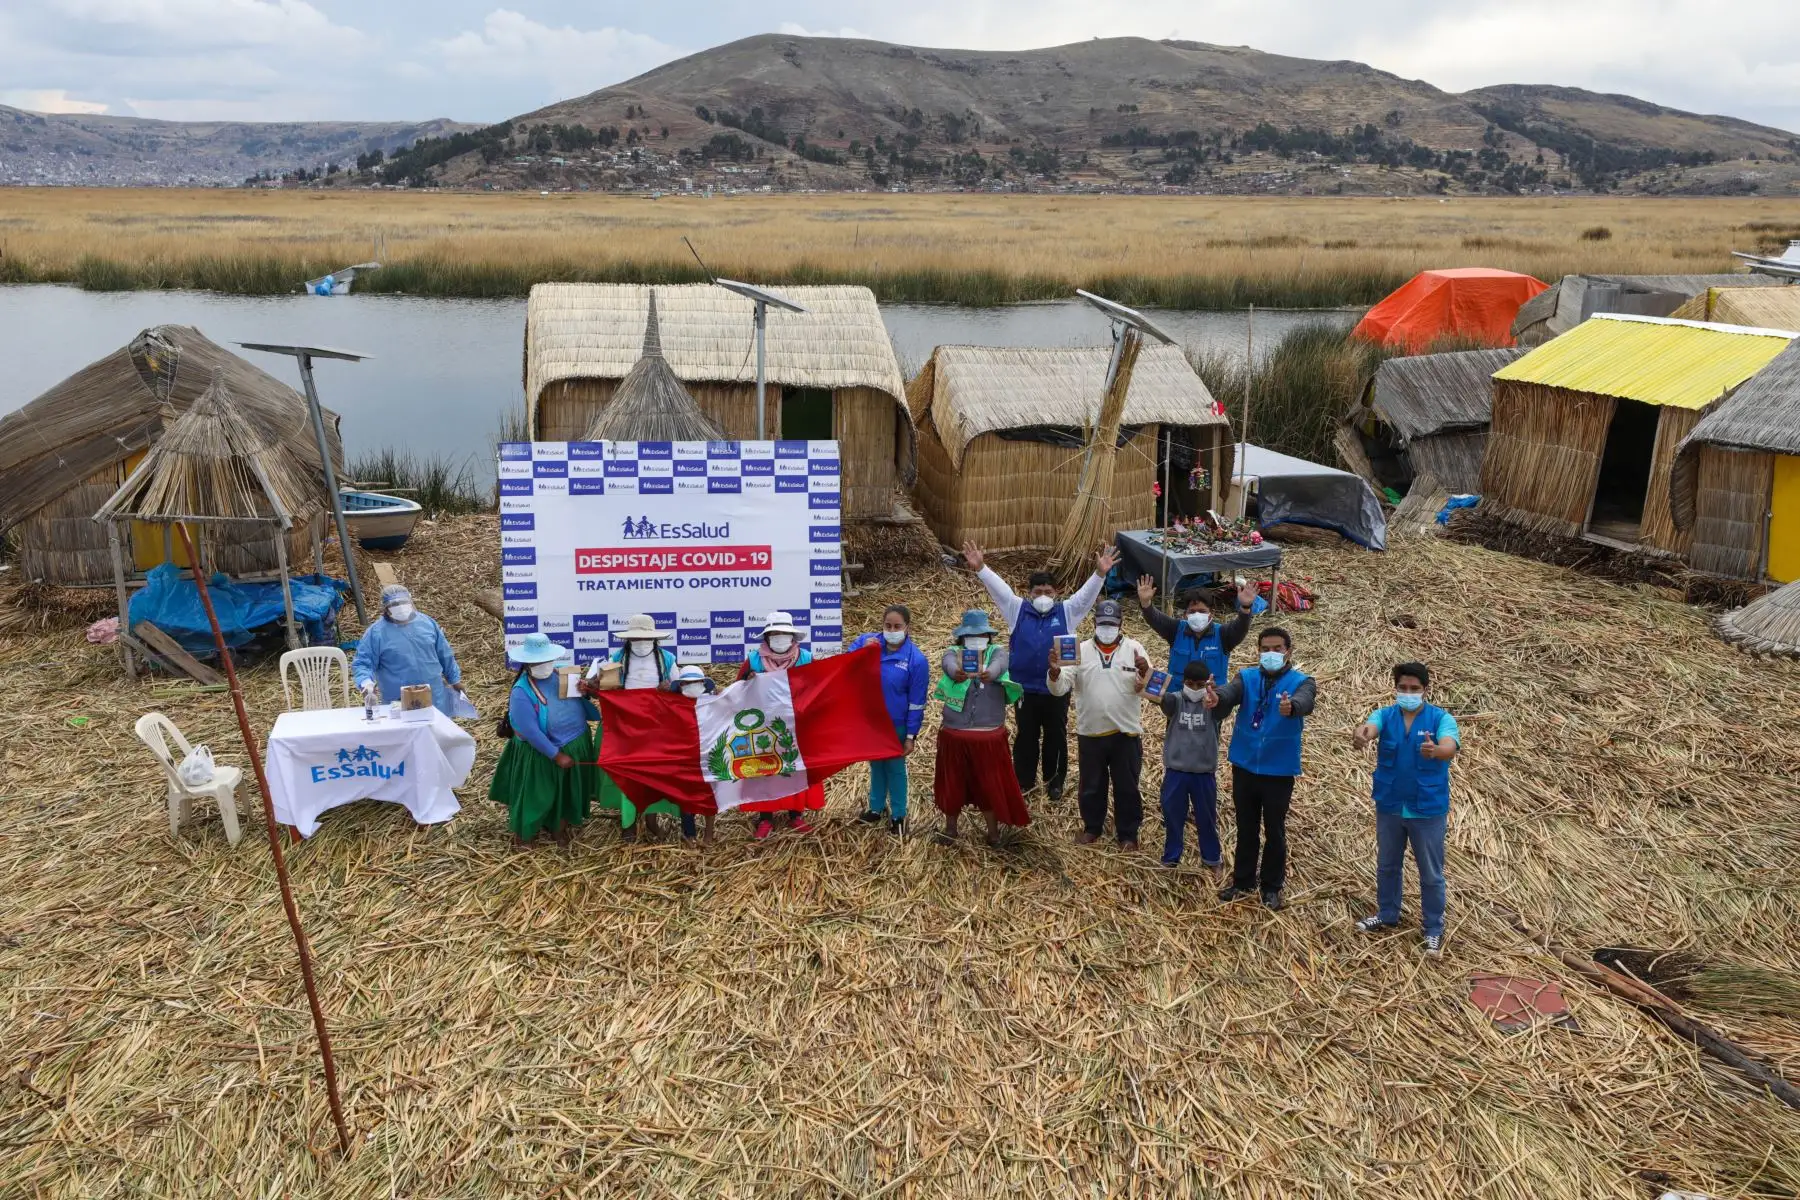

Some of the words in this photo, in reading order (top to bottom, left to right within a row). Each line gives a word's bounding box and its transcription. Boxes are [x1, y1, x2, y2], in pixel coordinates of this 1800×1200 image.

[660, 522, 729, 539] EsSalud
[579, 554, 677, 570] DESPISTAJE
[682, 553, 736, 566] COVID
[751, 552, 768, 565] 19
[577, 578, 684, 591] TRATAMIENTO
[689, 576, 771, 588] OPORTUNO
[311, 760, 405, 783] EsSalud
